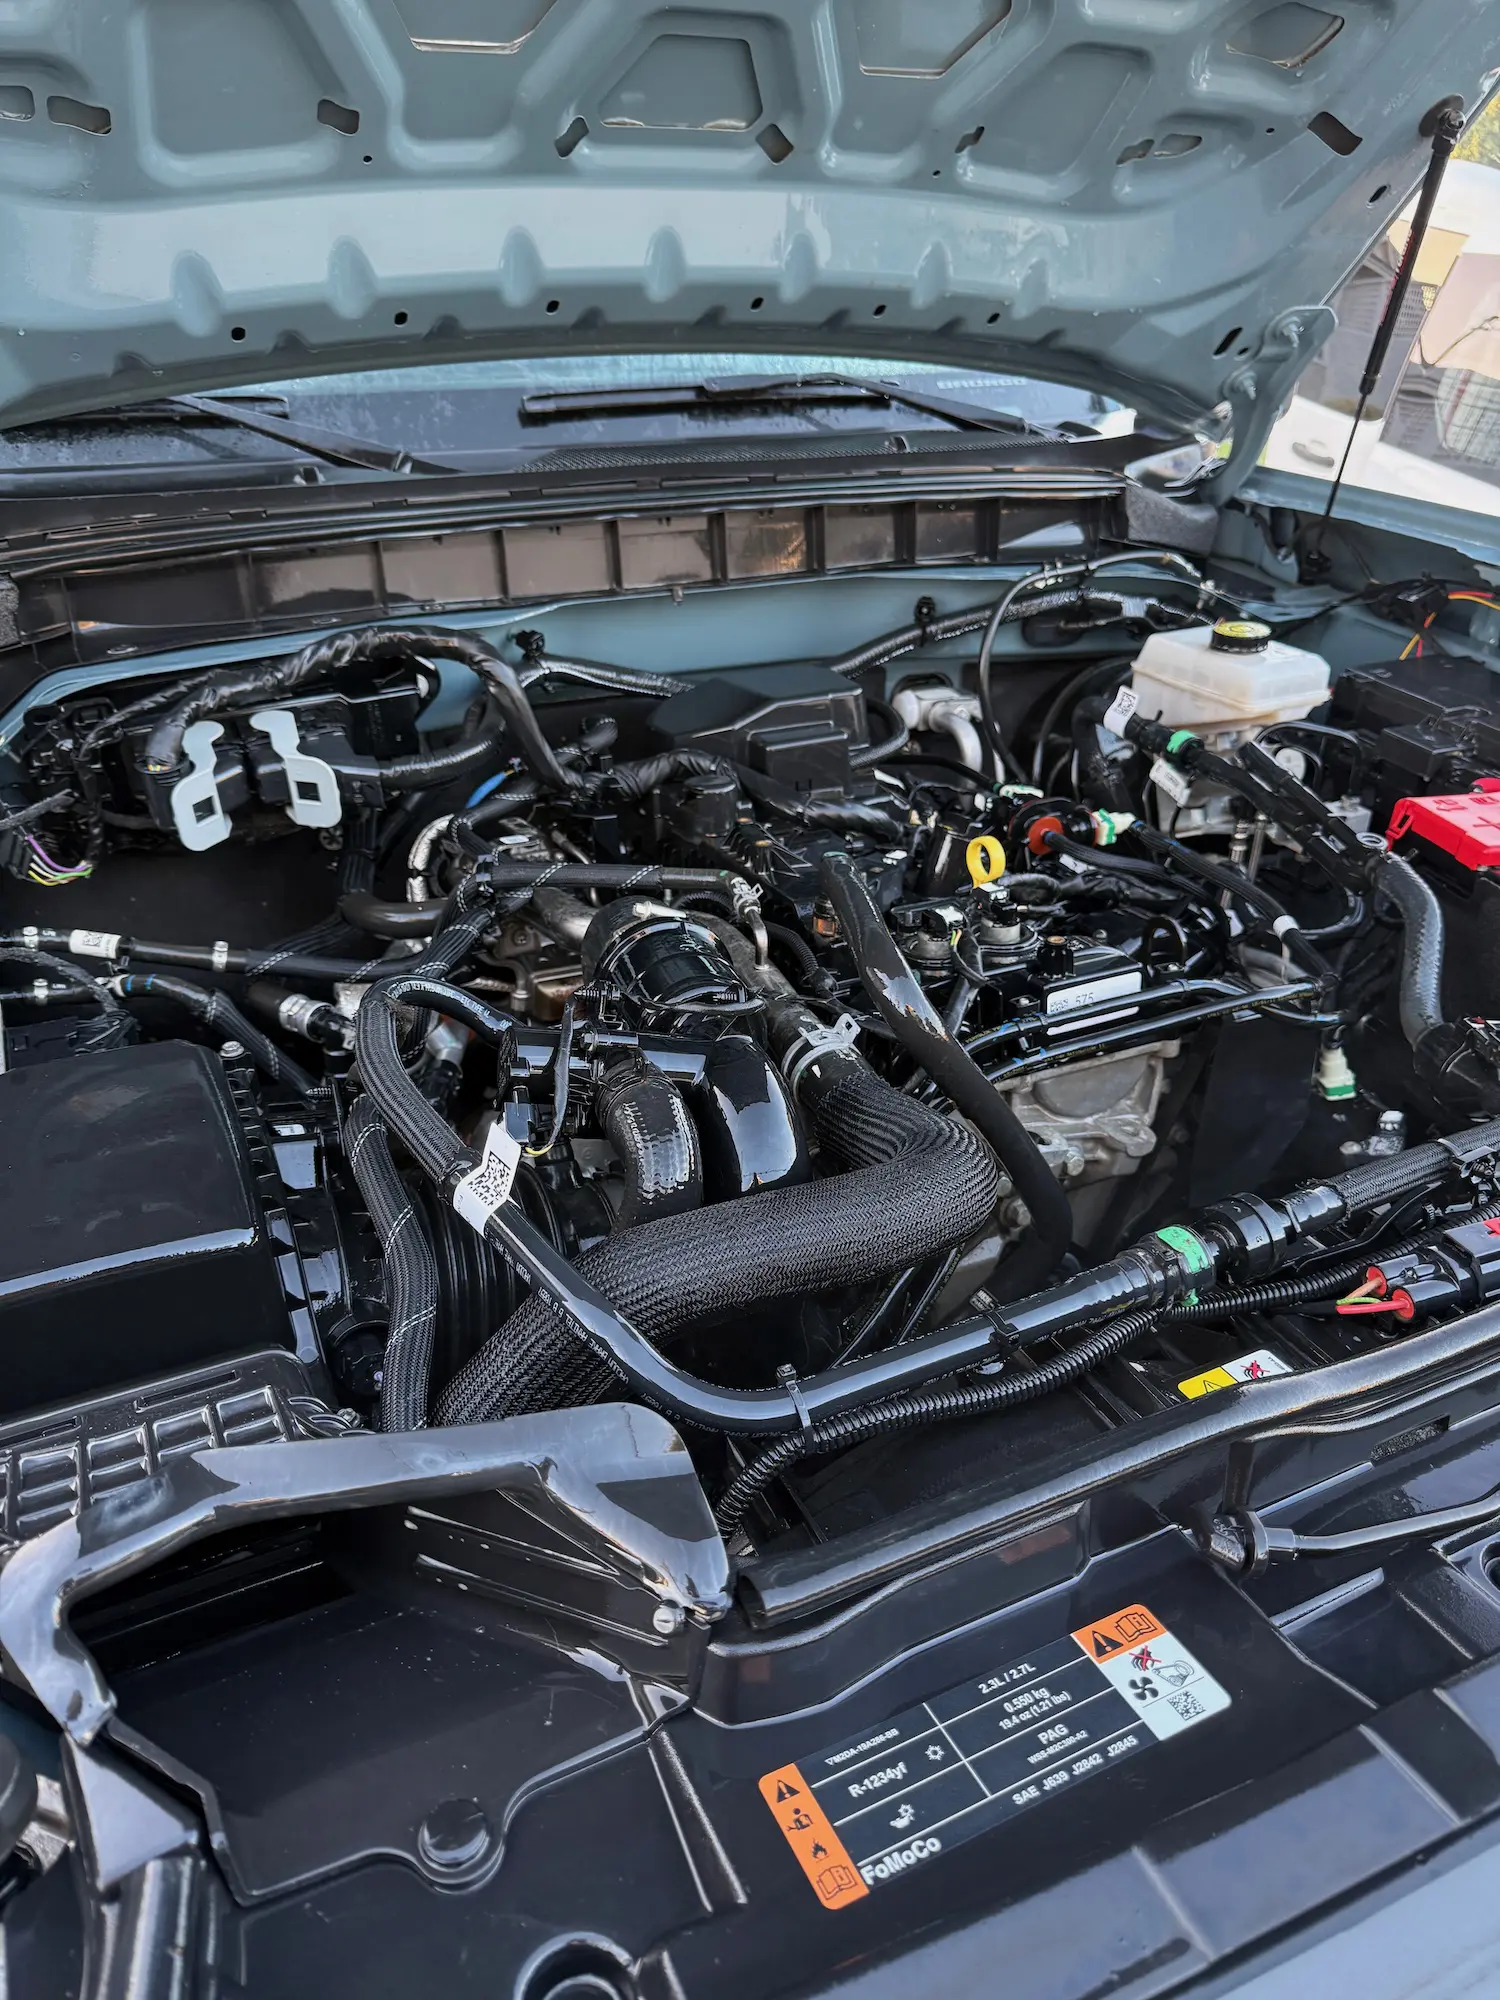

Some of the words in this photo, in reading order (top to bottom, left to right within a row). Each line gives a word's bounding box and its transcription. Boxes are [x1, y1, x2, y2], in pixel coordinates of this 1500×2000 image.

[587, 1338, 608, 1361] BRAKE
[978, 1677, 1006, 1694] 2.3L
[1009, 1663, 1037, 1679] 2.7L
[999, 1715, 1020, 1730] 19.4
[1019, 1710, 1033, 1720] oz
[1030, 1699, 1053, 1717] (1.21
[1050, 1691, 1072, 1705] lbs)
[1003, 1693, 1035, 1713] 0.550
[1031, 1688, 1050, 1700] kg
[1037, 1724, 1069, 1745] PAG
[848, 1762, 908, 1798] R-1234yf
[1012, 1785, 1041, 1805] SAE
[1042, 1770, 1070, 1791] J639
[1071, 1753, 1104, 1776] J2842
[1107, 1735, 1139, 1757] J2845
[860, 1837, 942, 1886] FoMoCo
